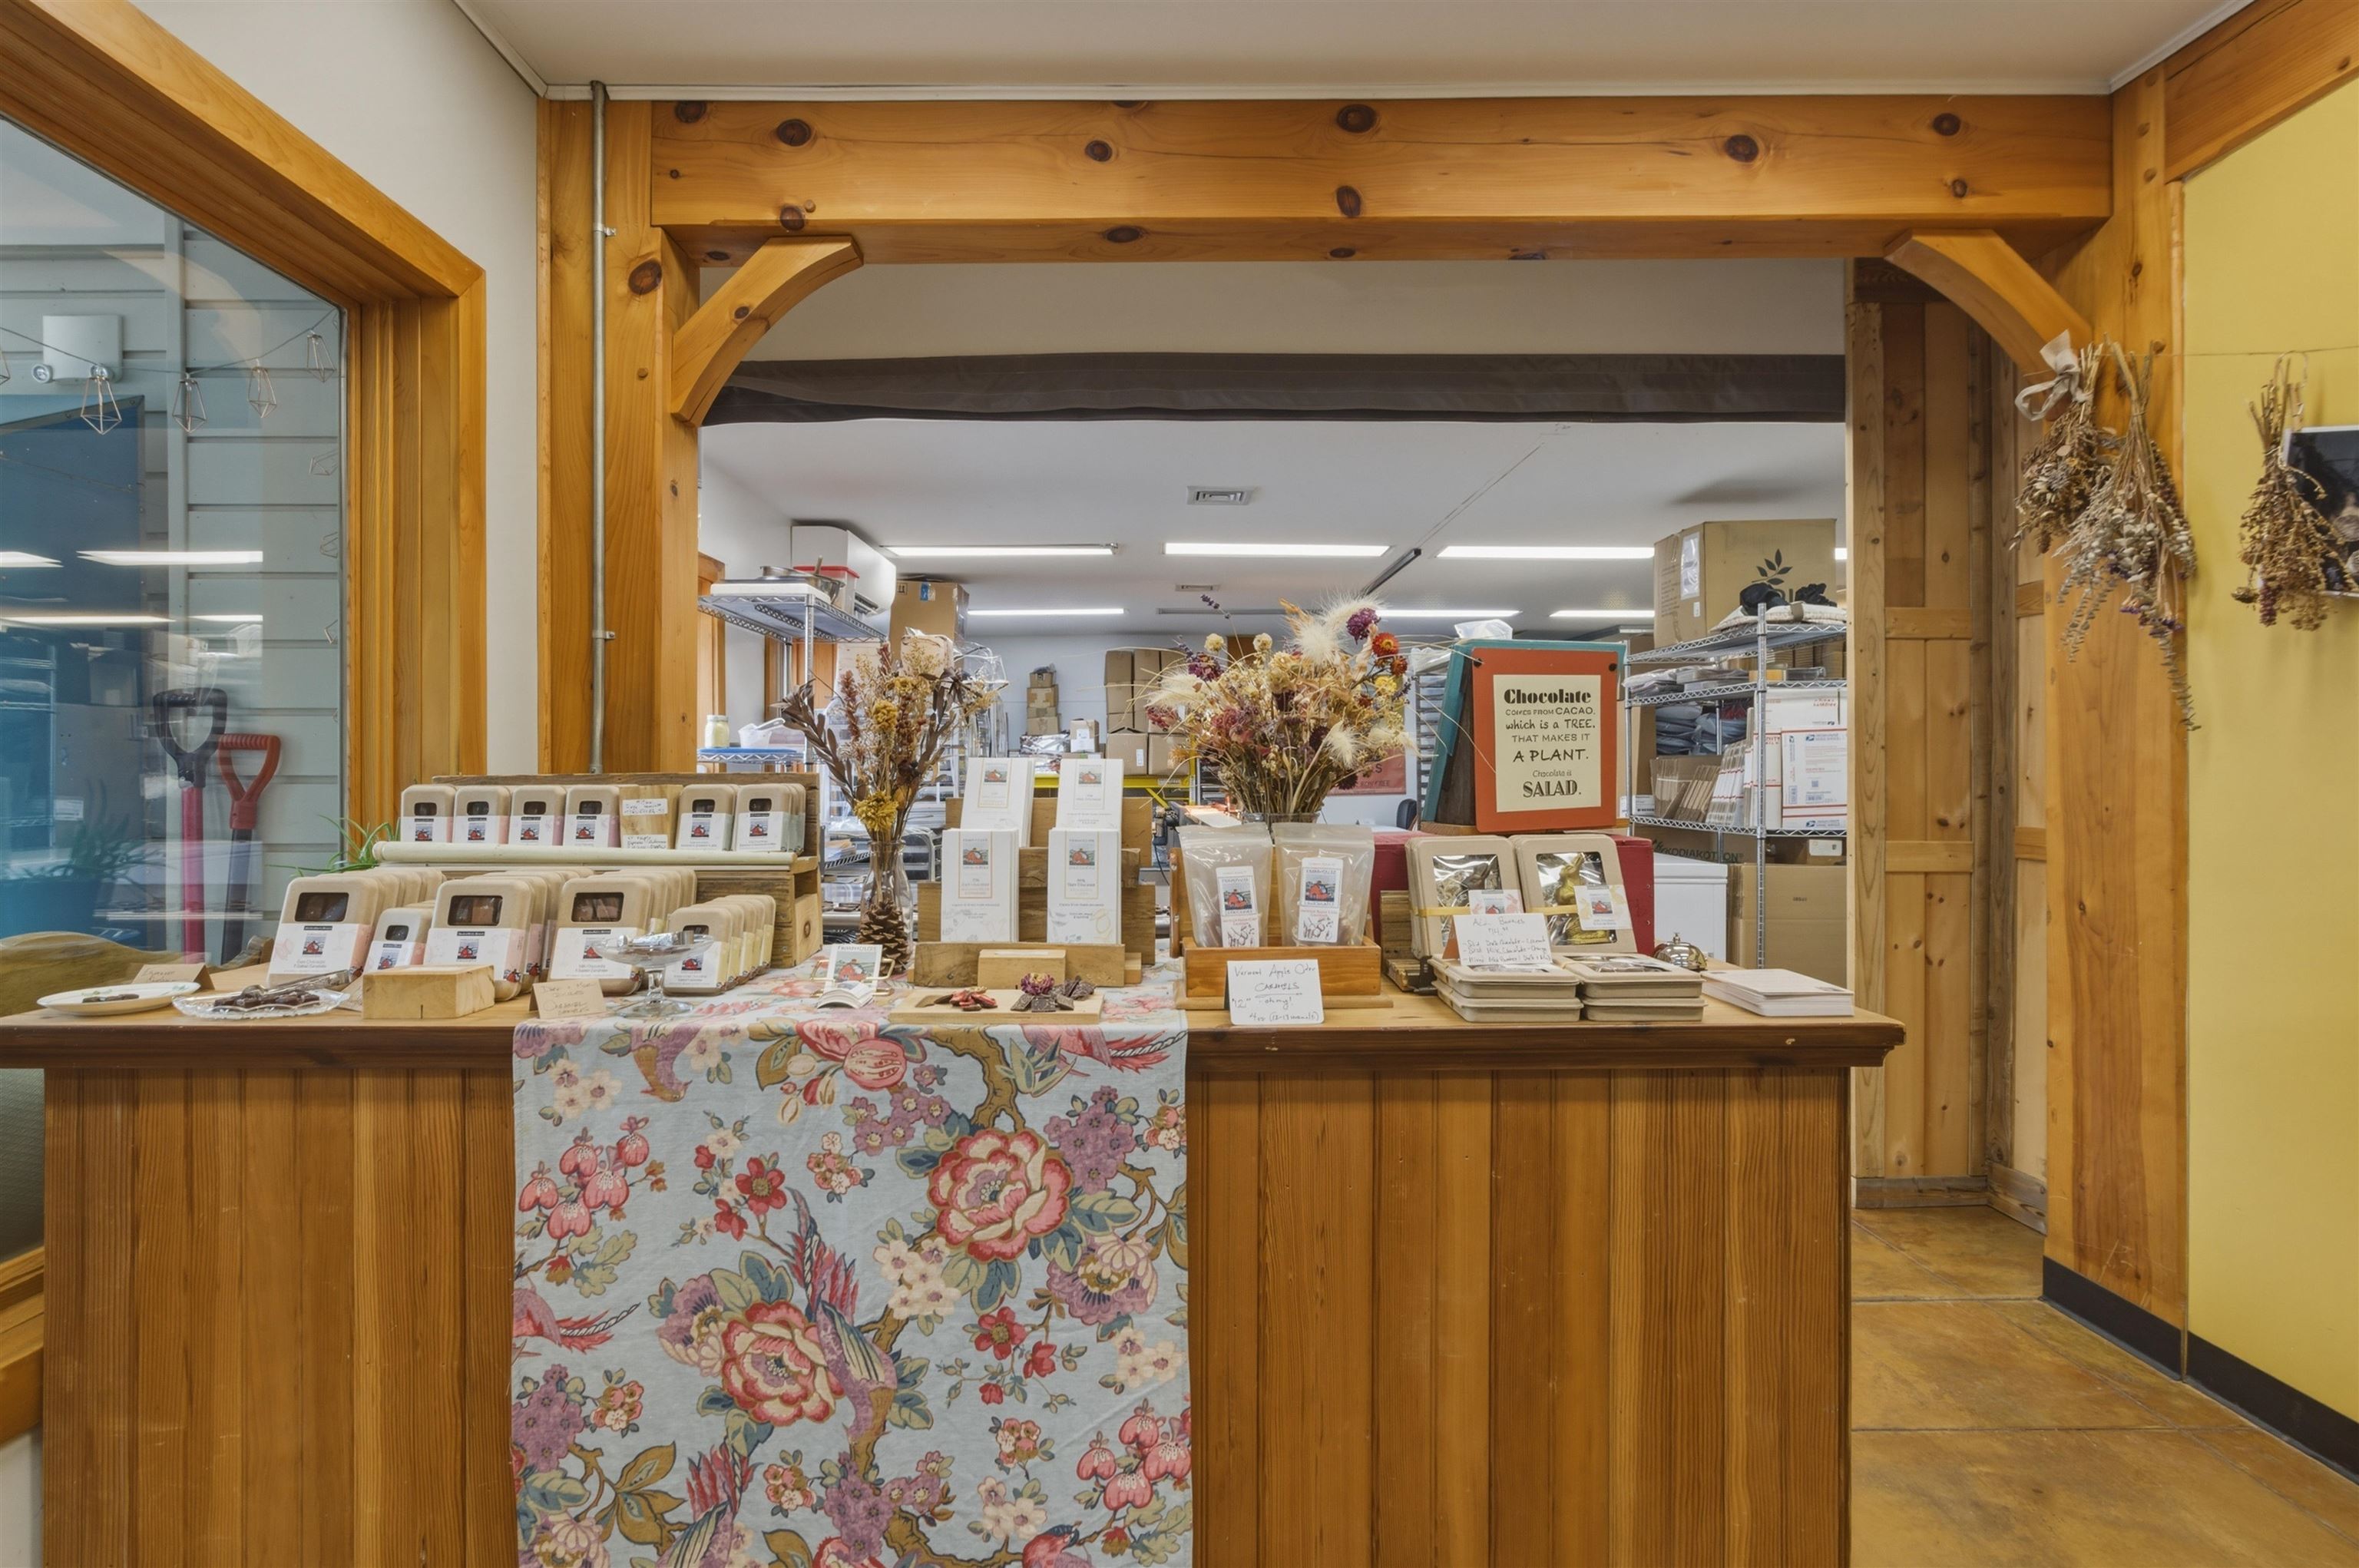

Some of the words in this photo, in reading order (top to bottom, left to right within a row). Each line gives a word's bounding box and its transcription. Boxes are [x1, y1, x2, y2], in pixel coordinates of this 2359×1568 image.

[1504, 688, 1592, 704] Chocolate
[1505, 719, 1536, 729] which
[1540, 719, 1549, 729] is
[1553, 721, 1560, 729] a
[1564, 718, 1596, 729] TREE.
[1511, 734, 1539, 743] THAT
[1542, 733, 1577, 743] MAKES
[1581, 733, 1590, 742] IT
[1512, 750, 1524, 762] A
[1529, 749, 1589, 762] PLANT.
[1522, 779, 1582, 799] SALAD.
